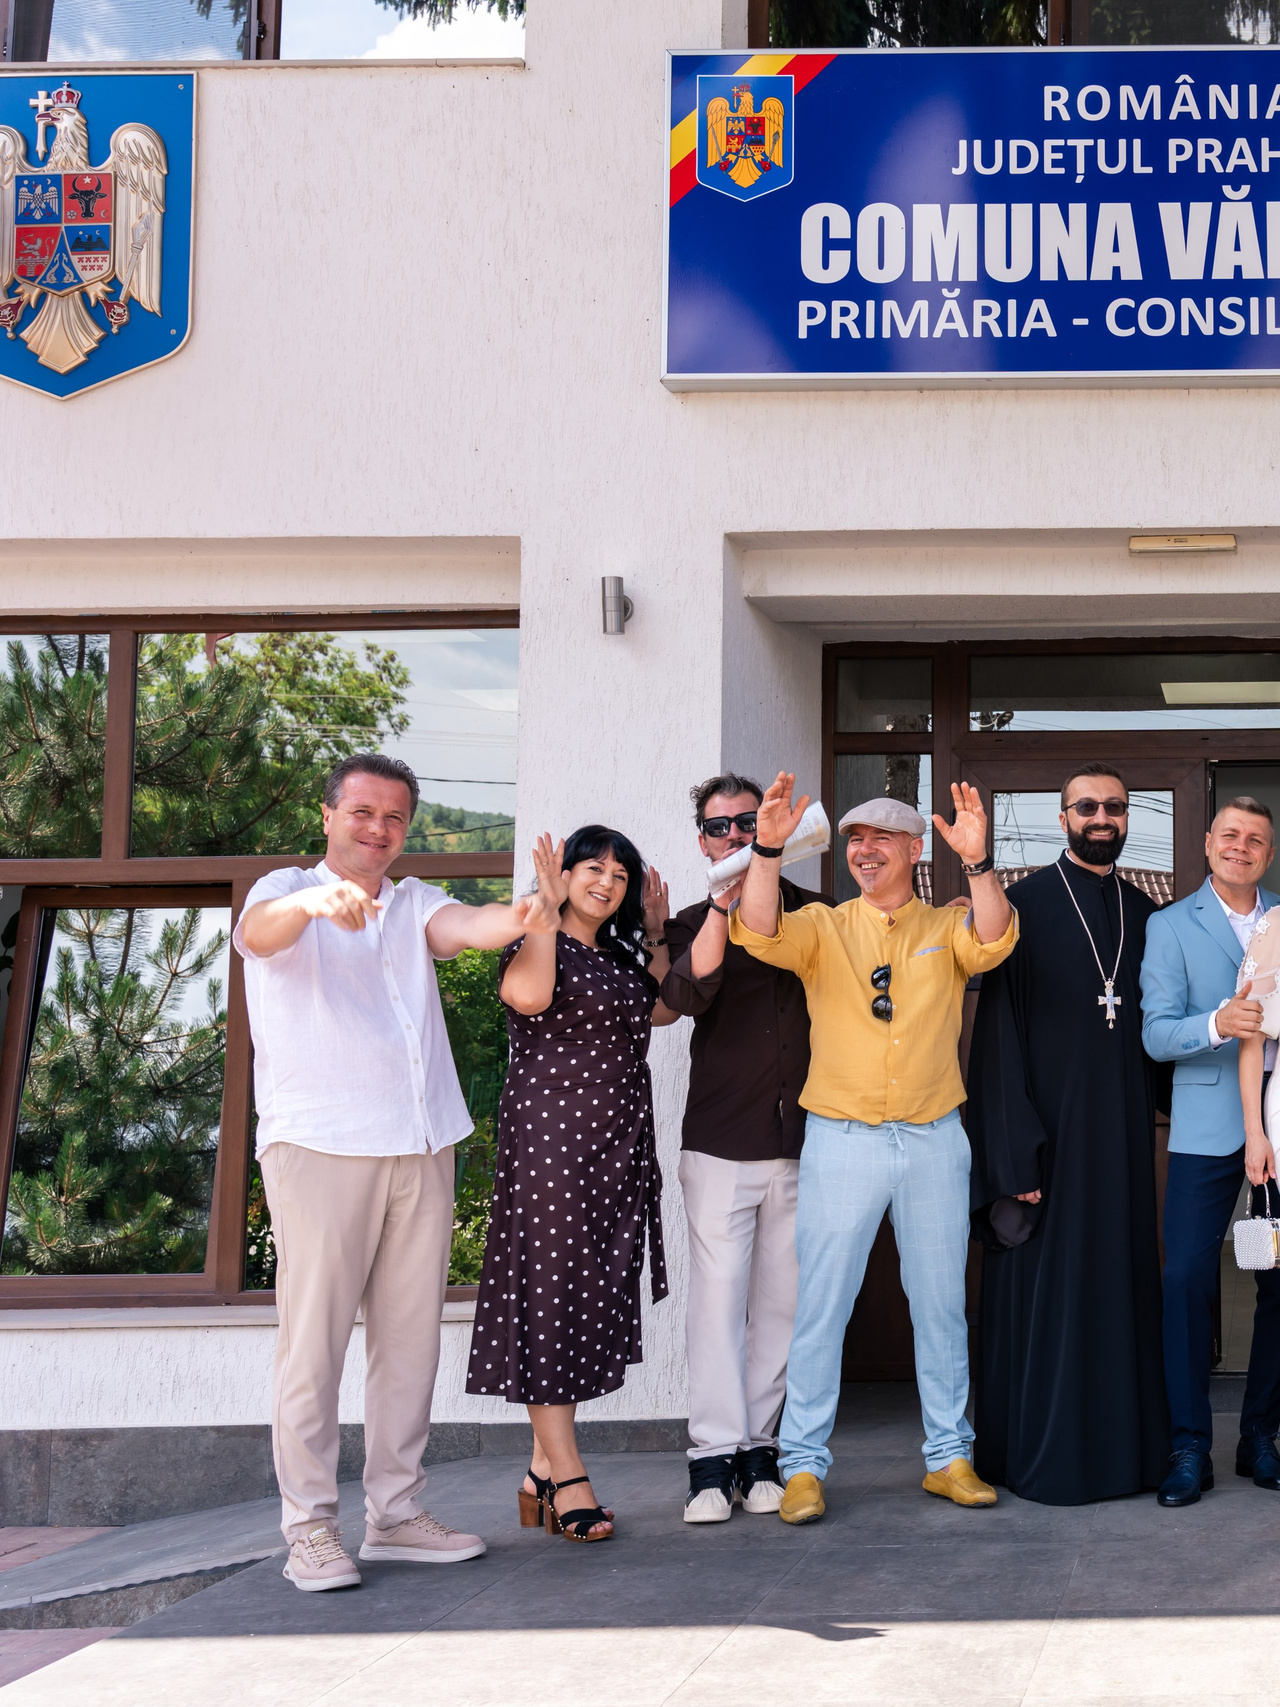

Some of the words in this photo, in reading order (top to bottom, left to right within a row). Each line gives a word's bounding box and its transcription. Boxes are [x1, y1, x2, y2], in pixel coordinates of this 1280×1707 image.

[952, 138, 1153, 184] JUDEȚUL
[800, 202, 1142, 284] COMUNA
[798, 287, 1057, 339] PRIMĂRIA
